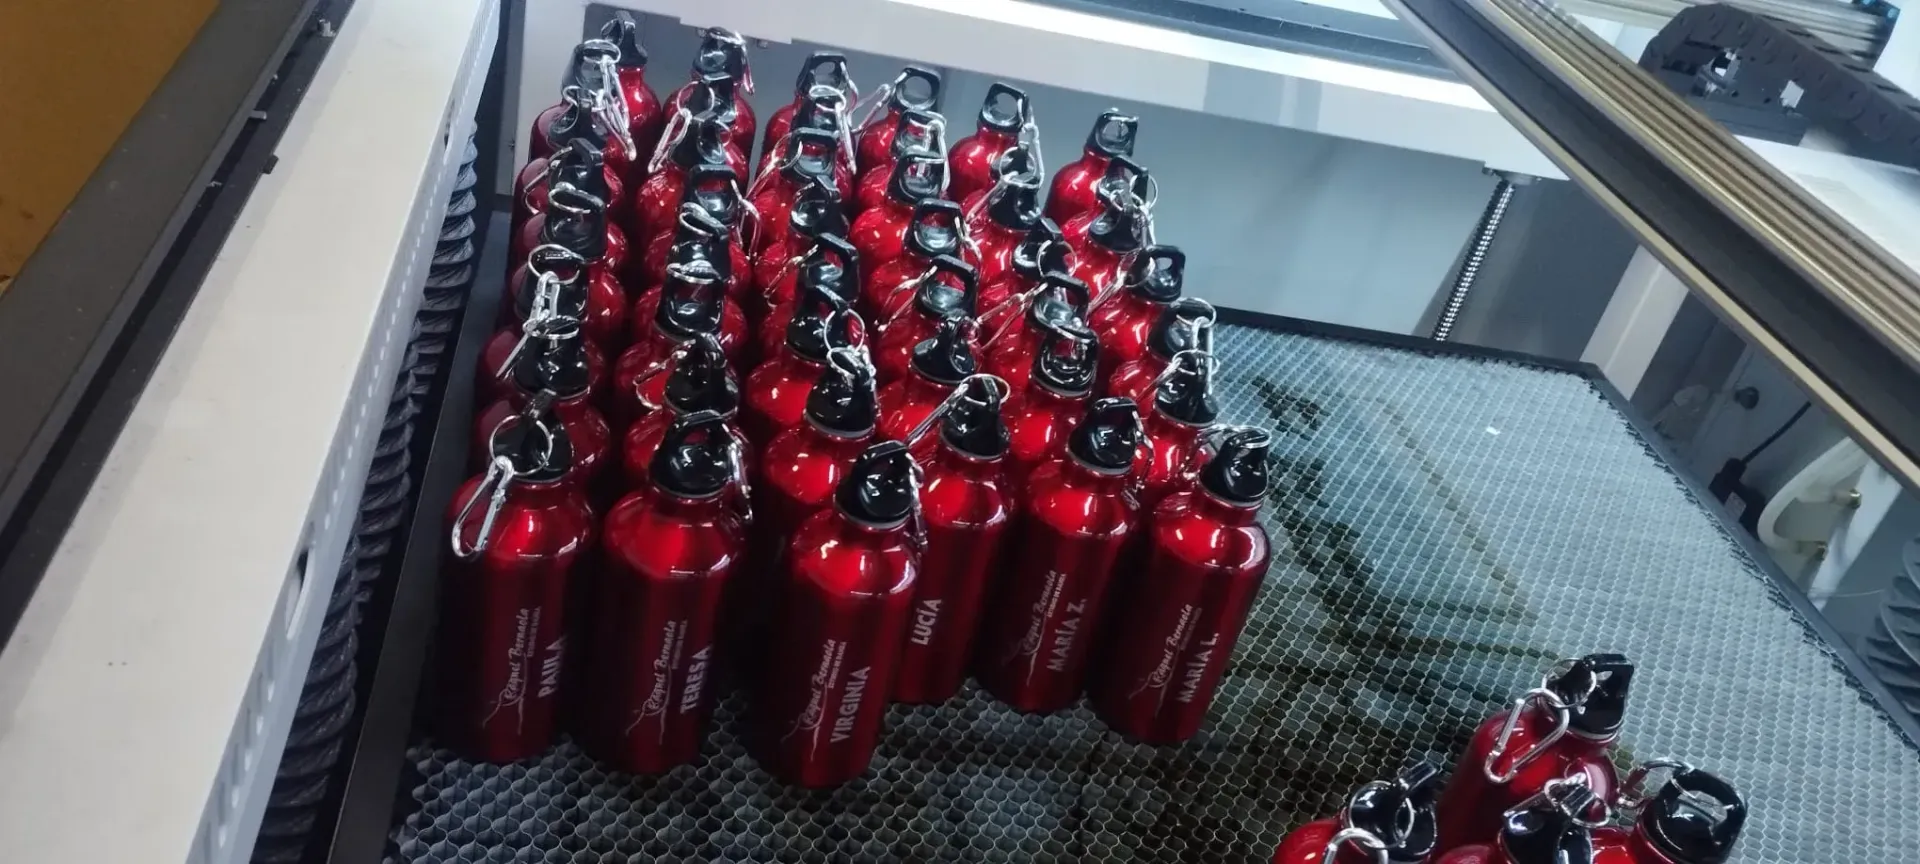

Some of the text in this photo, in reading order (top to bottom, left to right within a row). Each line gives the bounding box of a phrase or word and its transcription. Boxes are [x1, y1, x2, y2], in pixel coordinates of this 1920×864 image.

[911, 599, 942, 646] LUCÍA
[538, 634, 567, 698] PAULA
[680, 645, 713, 714] TERESA
[830, 666, 871, 743] VIRGINIA
